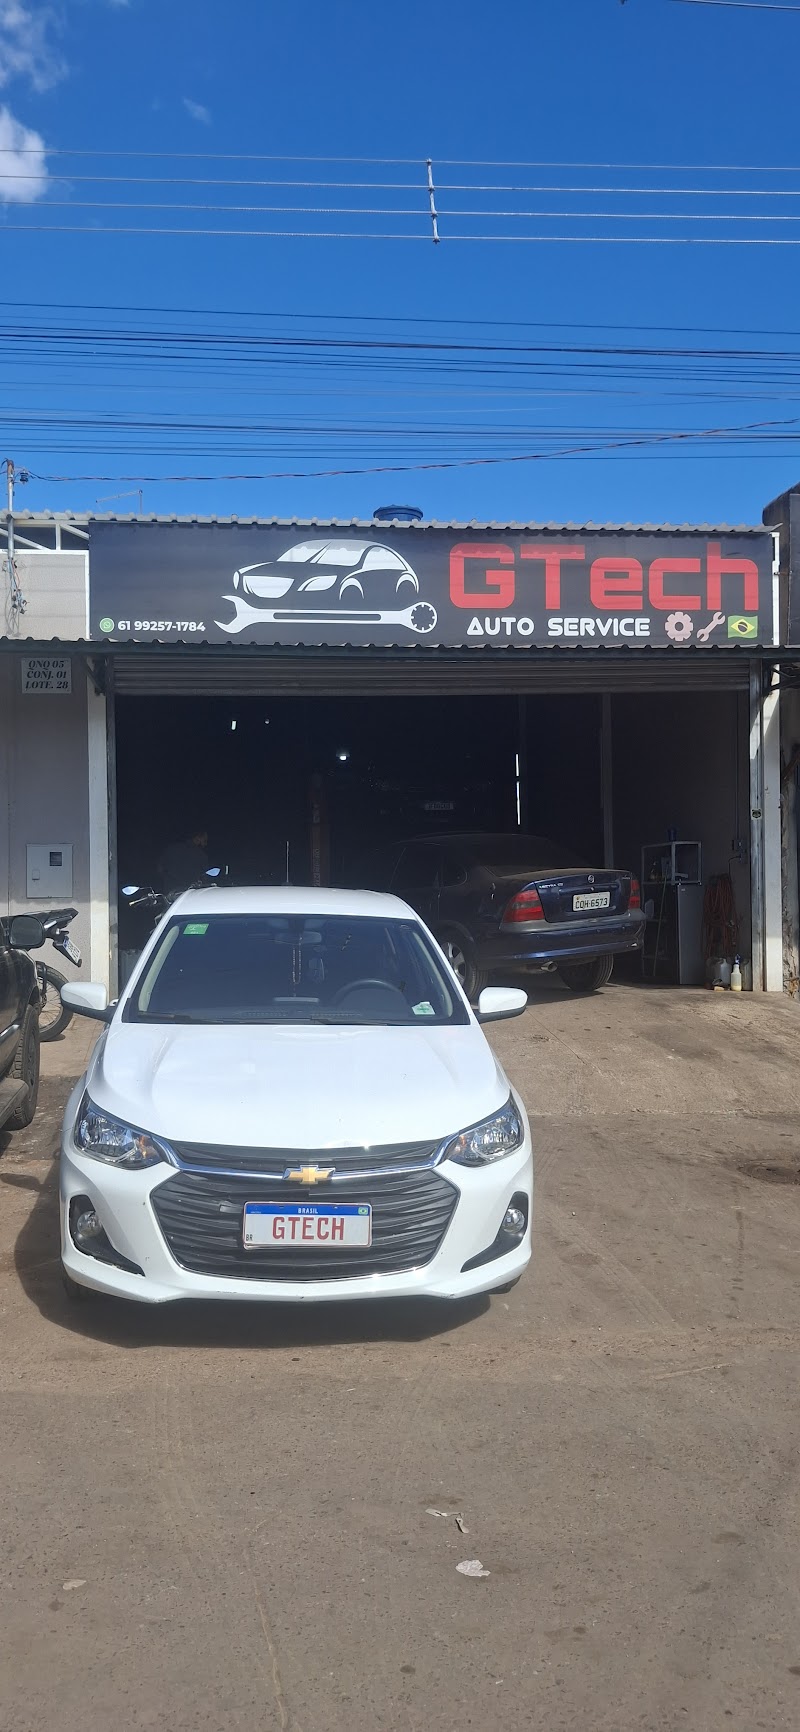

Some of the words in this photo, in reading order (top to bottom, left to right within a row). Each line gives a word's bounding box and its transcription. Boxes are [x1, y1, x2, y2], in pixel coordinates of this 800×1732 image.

[449, 542, 759, 611] GTech
[117, 620, 131, 631] 61
[134, 620, 206, 632] 99257-1784
[466, 616, 535, 636] AUTO
[547, 617, 651, 637] SERVICE
[28, 660, 51, 670] QNQ
[52, 660, 65, 669] 05
[26, 670, 54, 680] CONJ.
[56, 670, 67, 679] 01
[25, 680, 54, 689] LOTE.
[56, 680, 69, 689] 28
[297, 1207, 319, 1215] BRASIL
[272, 1216, 345, 1241] GTECH
[245, 1234, 253, 1242] BR
